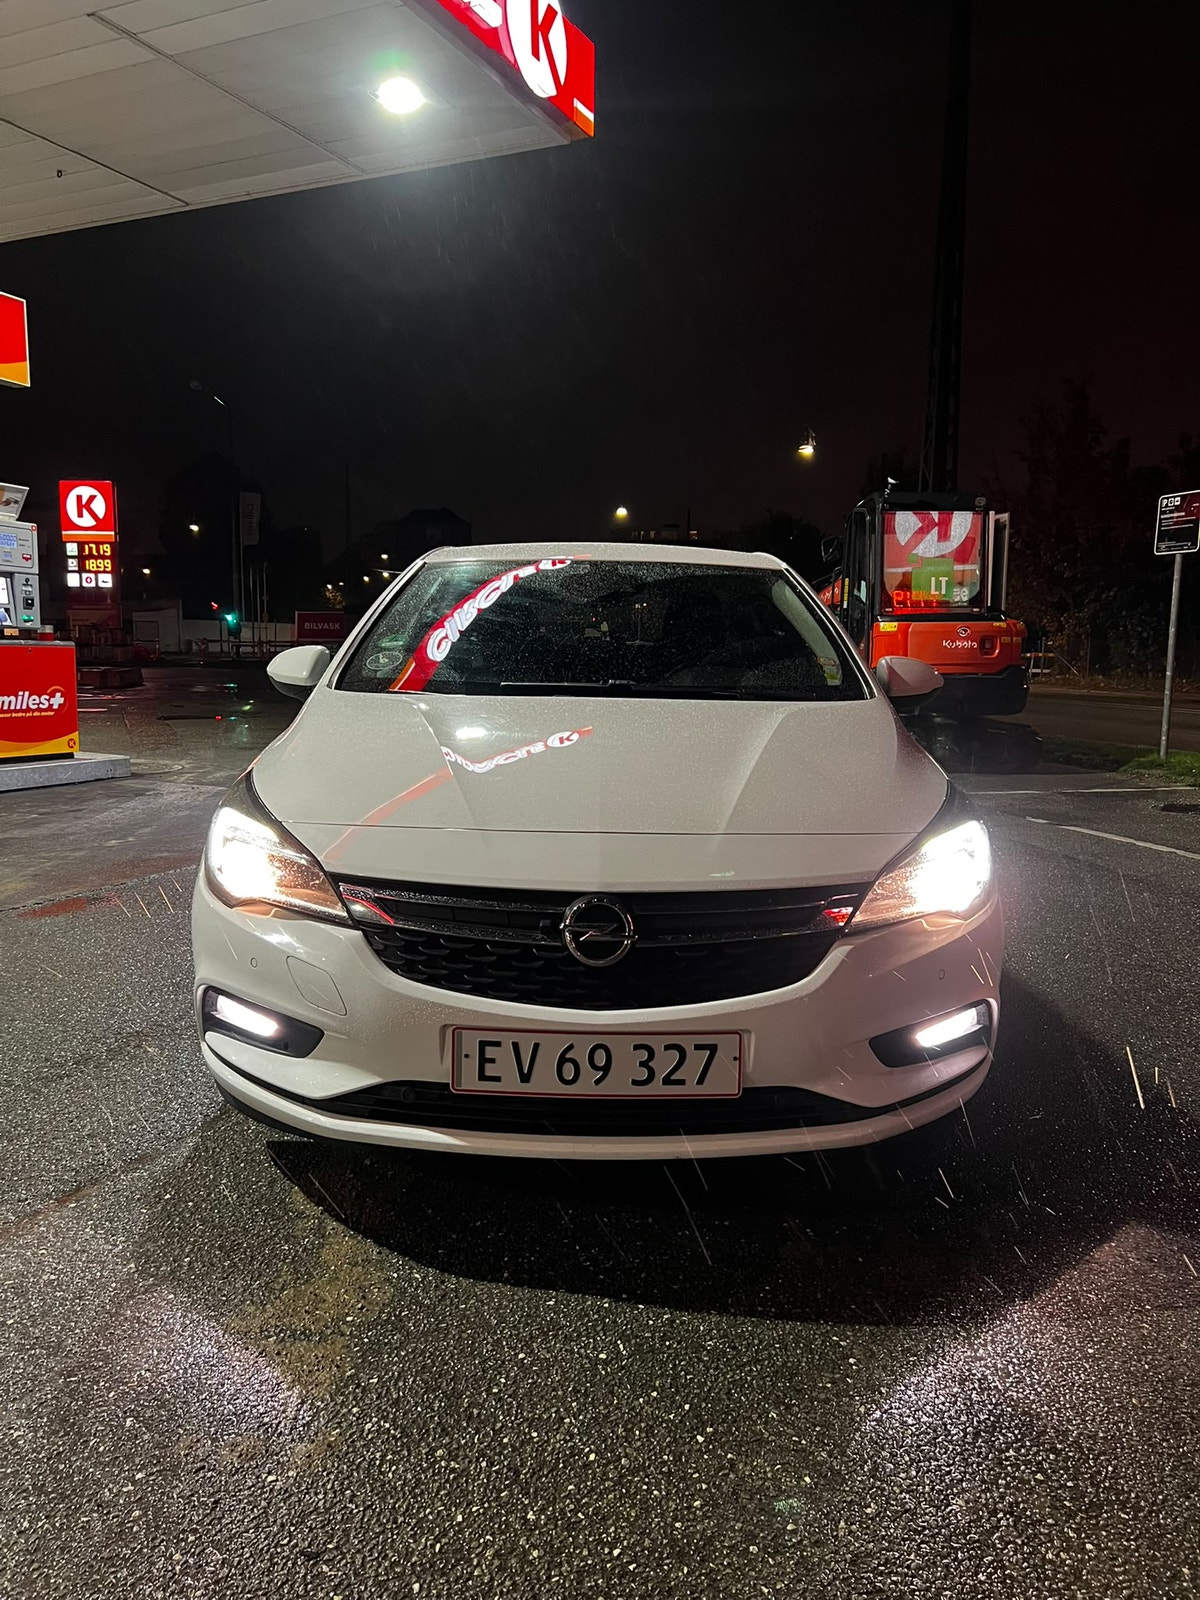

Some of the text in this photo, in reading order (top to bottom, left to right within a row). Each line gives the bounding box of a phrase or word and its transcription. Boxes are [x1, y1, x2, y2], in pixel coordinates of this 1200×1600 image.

[76, 494, 102, 524] K
[85, 559, 112, 571] 18.99
[930, 576, 949, 595] LT
[304, 622, 341, 630] BILVASK
[942, 639, 978, 649] Kubota
[477, 1039, 719, 1087] EV 69 327
